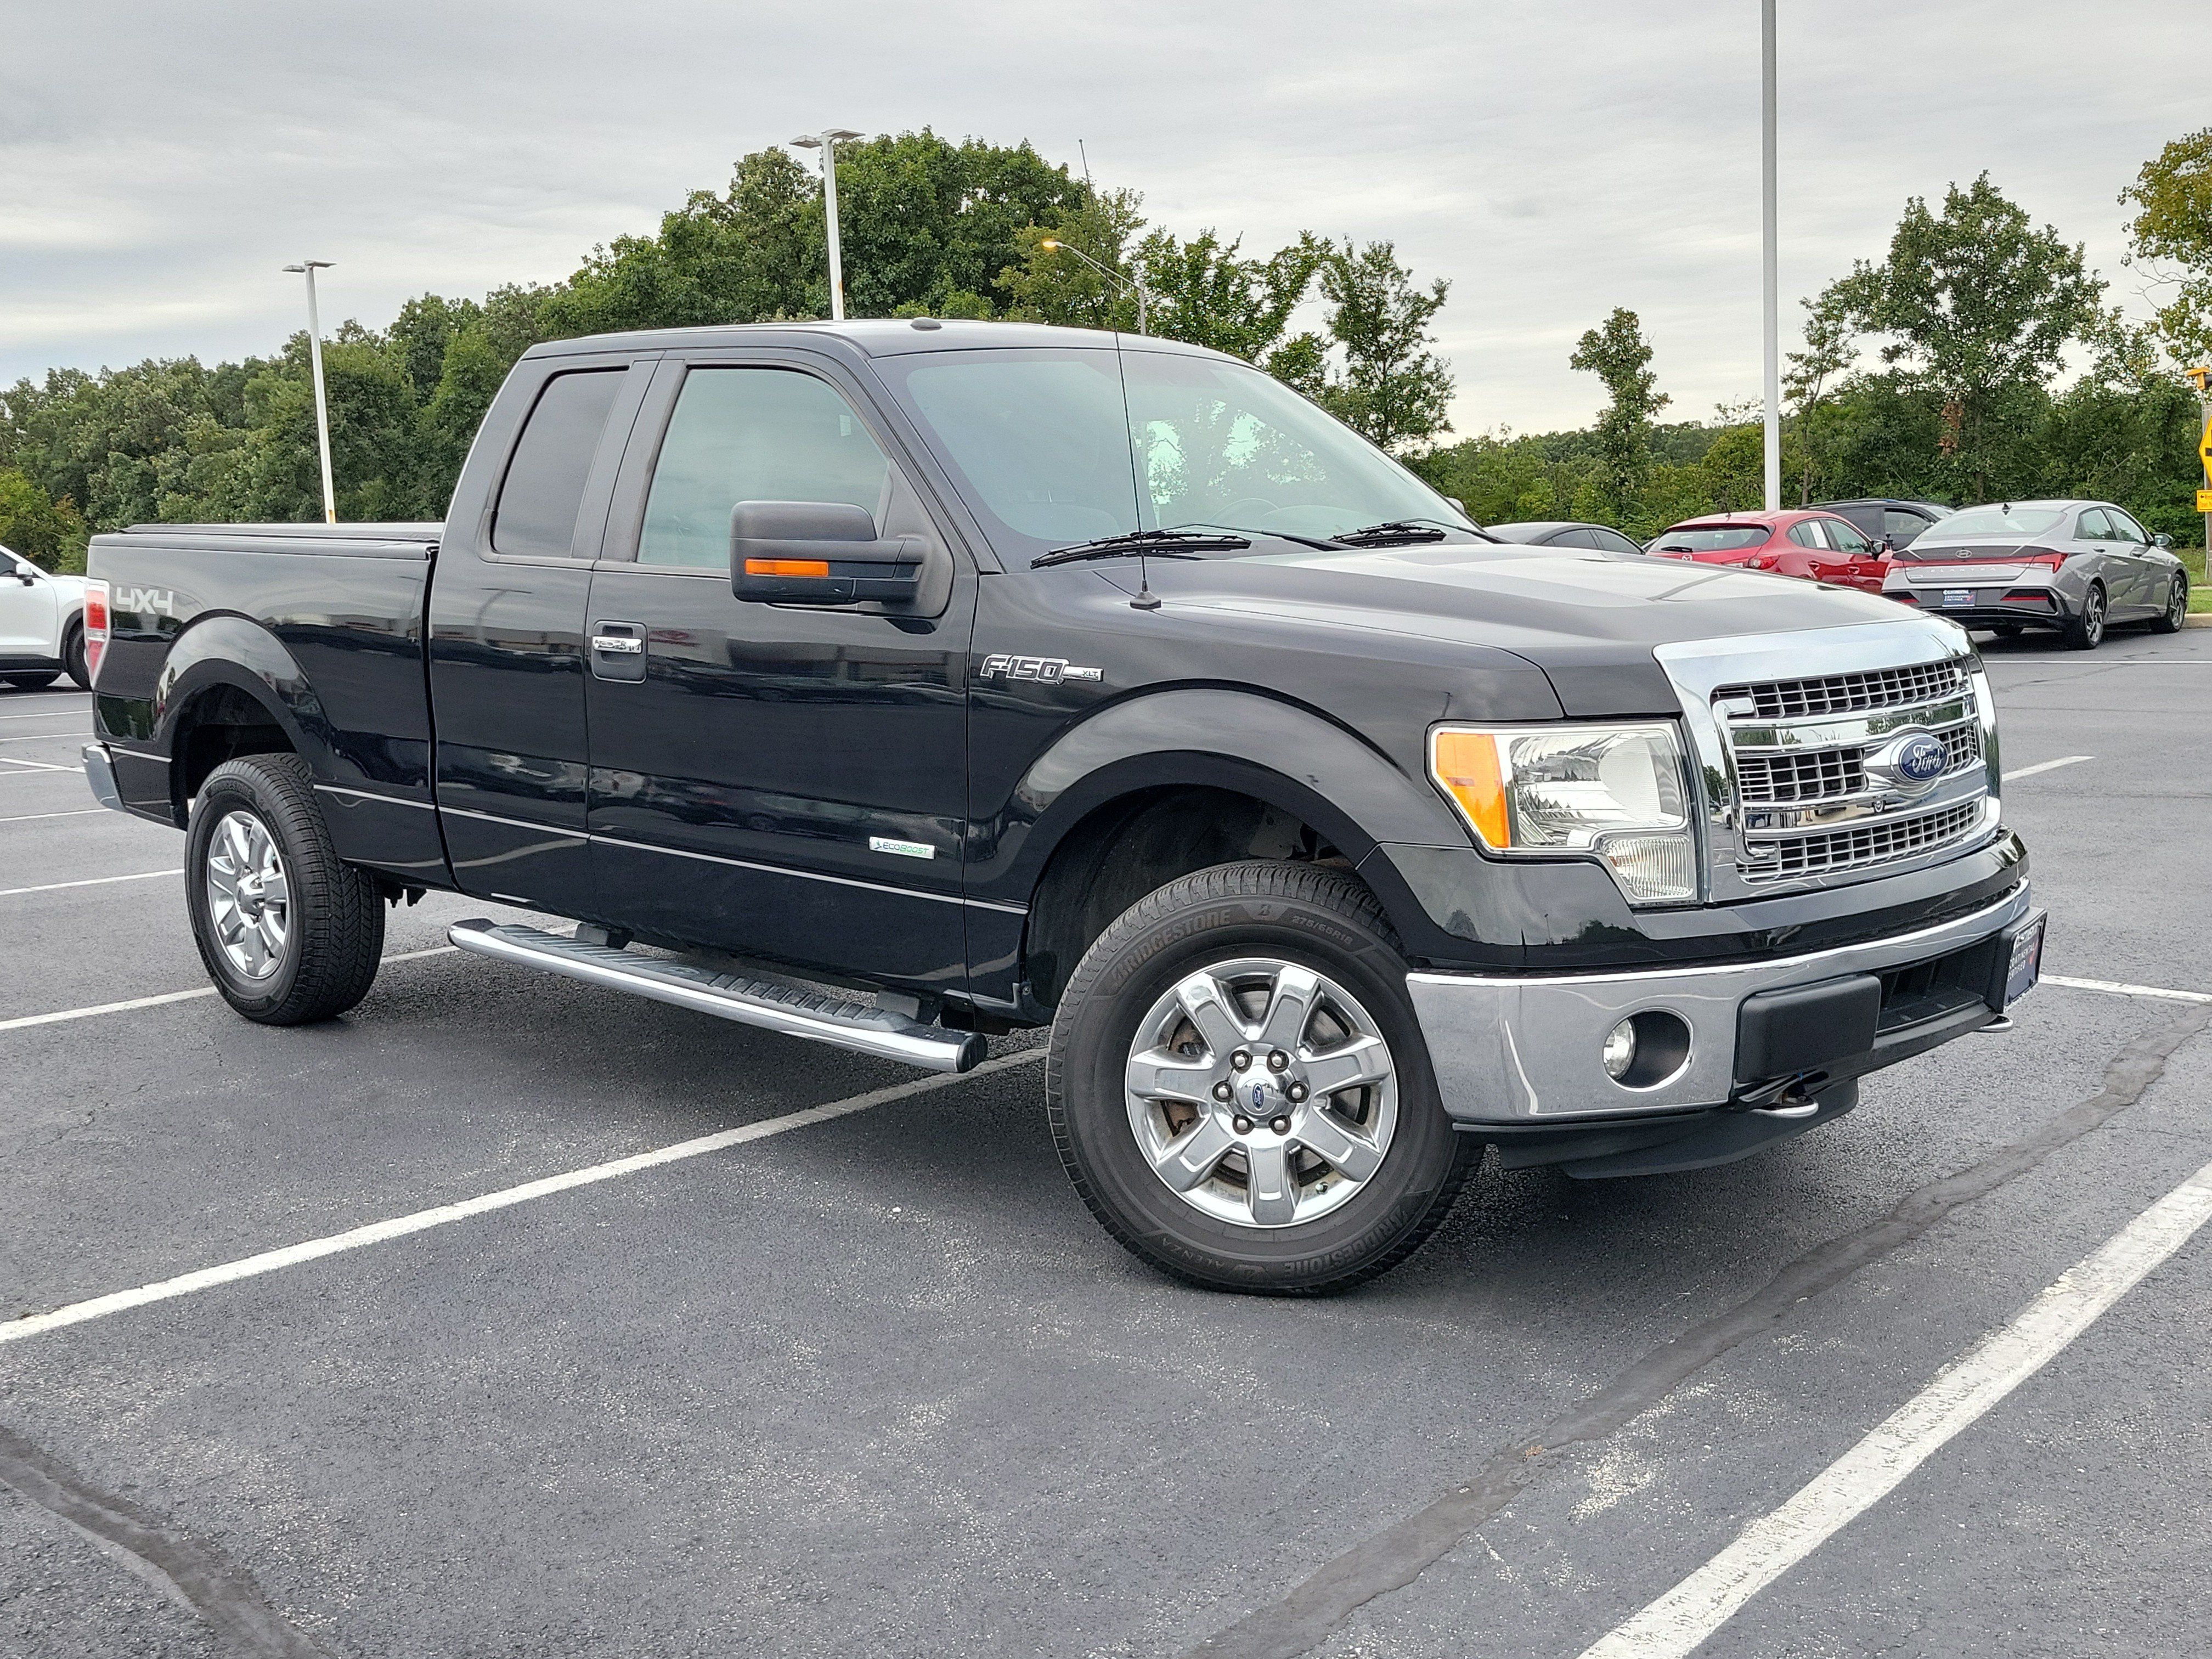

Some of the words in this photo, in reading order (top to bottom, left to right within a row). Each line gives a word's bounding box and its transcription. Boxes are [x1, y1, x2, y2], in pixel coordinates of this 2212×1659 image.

[1912, 743, 1944, 774] Ford
[1111, 908, 1231, 984] BRIDGESTONE
[1161, 1237, 1226, 1268] ALENZA
[1283, 1205, 1409, 1278] BRIDGESTONE
